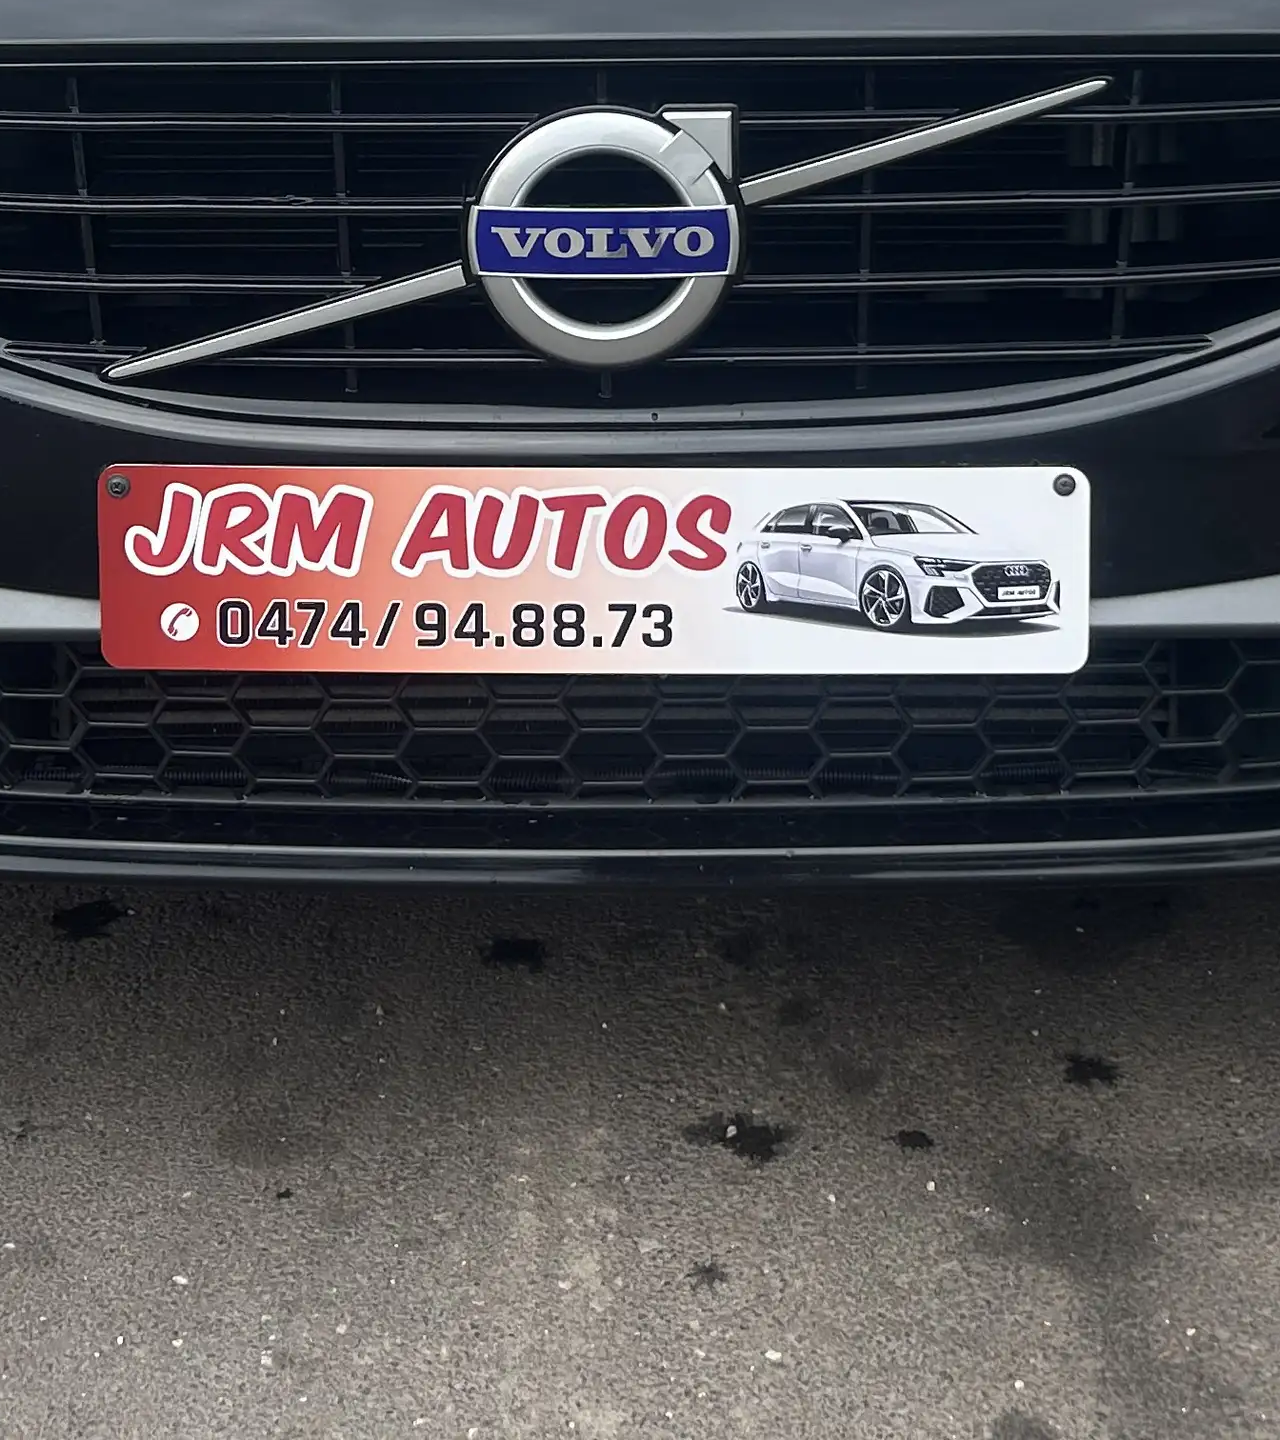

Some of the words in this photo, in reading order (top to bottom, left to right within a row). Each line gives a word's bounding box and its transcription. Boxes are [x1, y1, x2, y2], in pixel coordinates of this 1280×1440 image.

[491, 225, 715, 258] VOLVO
[125, 483, 374, 577] JRM
[393, 486, 733, 577] AUTOS
